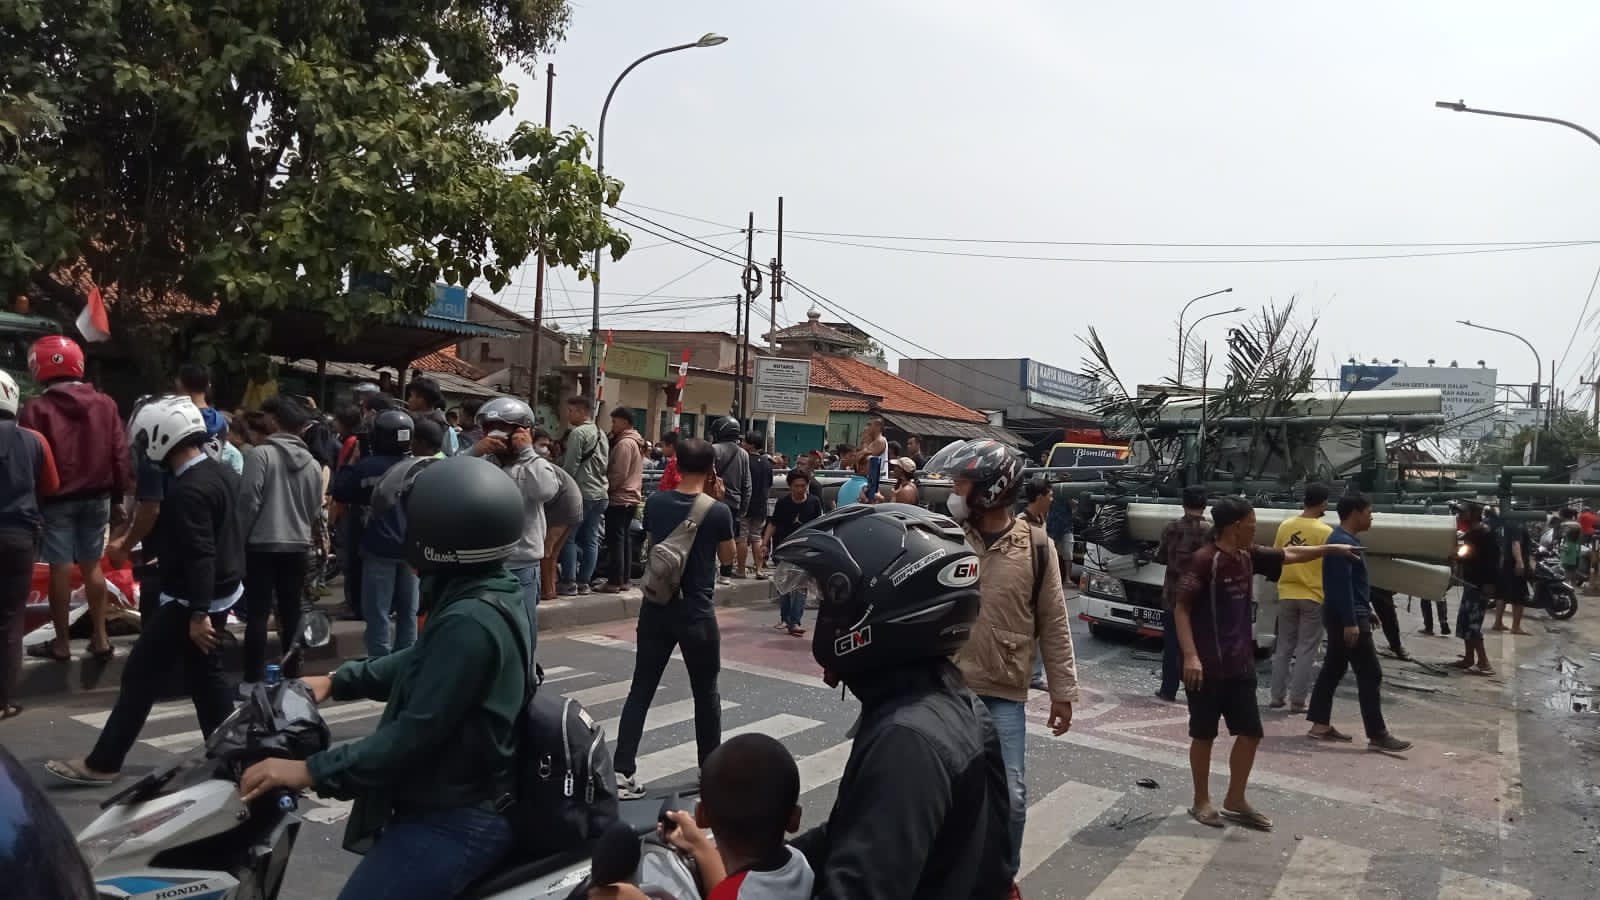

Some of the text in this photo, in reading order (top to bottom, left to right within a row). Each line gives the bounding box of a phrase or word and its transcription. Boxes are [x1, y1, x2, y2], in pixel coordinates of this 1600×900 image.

[424, 546, 458, 562] Classic
[953, 563, 978, 578] GM
[834, 625, 872, 656] GM
[155, 883, 209, 900] HONDA
